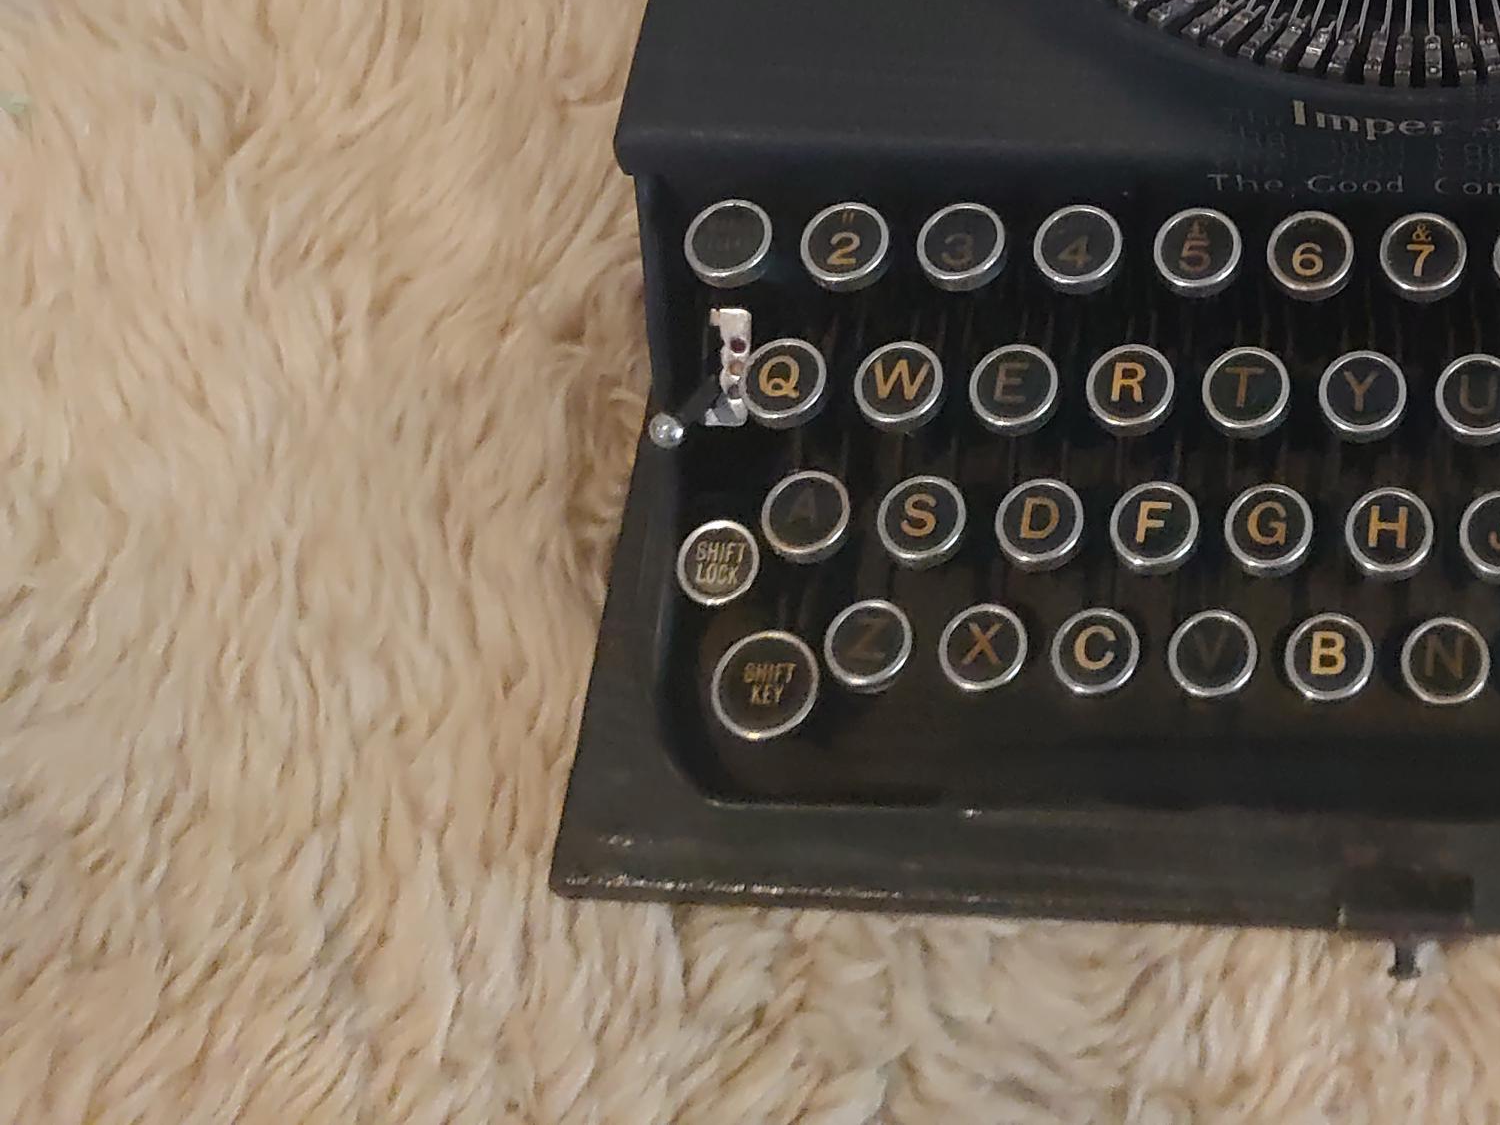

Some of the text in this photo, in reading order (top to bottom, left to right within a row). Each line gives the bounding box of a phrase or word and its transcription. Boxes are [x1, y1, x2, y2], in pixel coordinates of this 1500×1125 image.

[1207, 173, 1284, 194] The
[1307, 173, 1404, 195] Good
[826, 231, 861, 265] 2
[941, 232, 973, 267] 3
[1056, 235, 1091, 269] 4
[1179, 240, 1211, 274] 5
[1291, 242, 1323, 276] 6
[1406, 243, 1435, 277] 7
[758, 354, 800, 399] Q
[873, 359, 930, 401] W
[993, 361, 1029, 403] E
[1110, 361, 1146, 403] R
[1225, 366, 1266, 408] T
[1343, 370, 1377, 412] Y
[1458, 375, 1498, 415] U
[901, 493, 938, 537] S
[1019, 496, 1060, 539] D
[1135, 501, 1172, 544] F
[1247, 500, 1287, 546] G
[1367, 505, 1409, 548] H
[696, 541, 746, 563] SHIFT
[696, 562, 739, 585] LOCK
[850, 618, 889, 661] Z
[962, 622, 1003, 665] X
[1073, 625, 1116, 670] C
[1310, 630, 1347, 675] B
[1423, 633, 1465, 677] N
[751, 683, 785, 705] KEY
